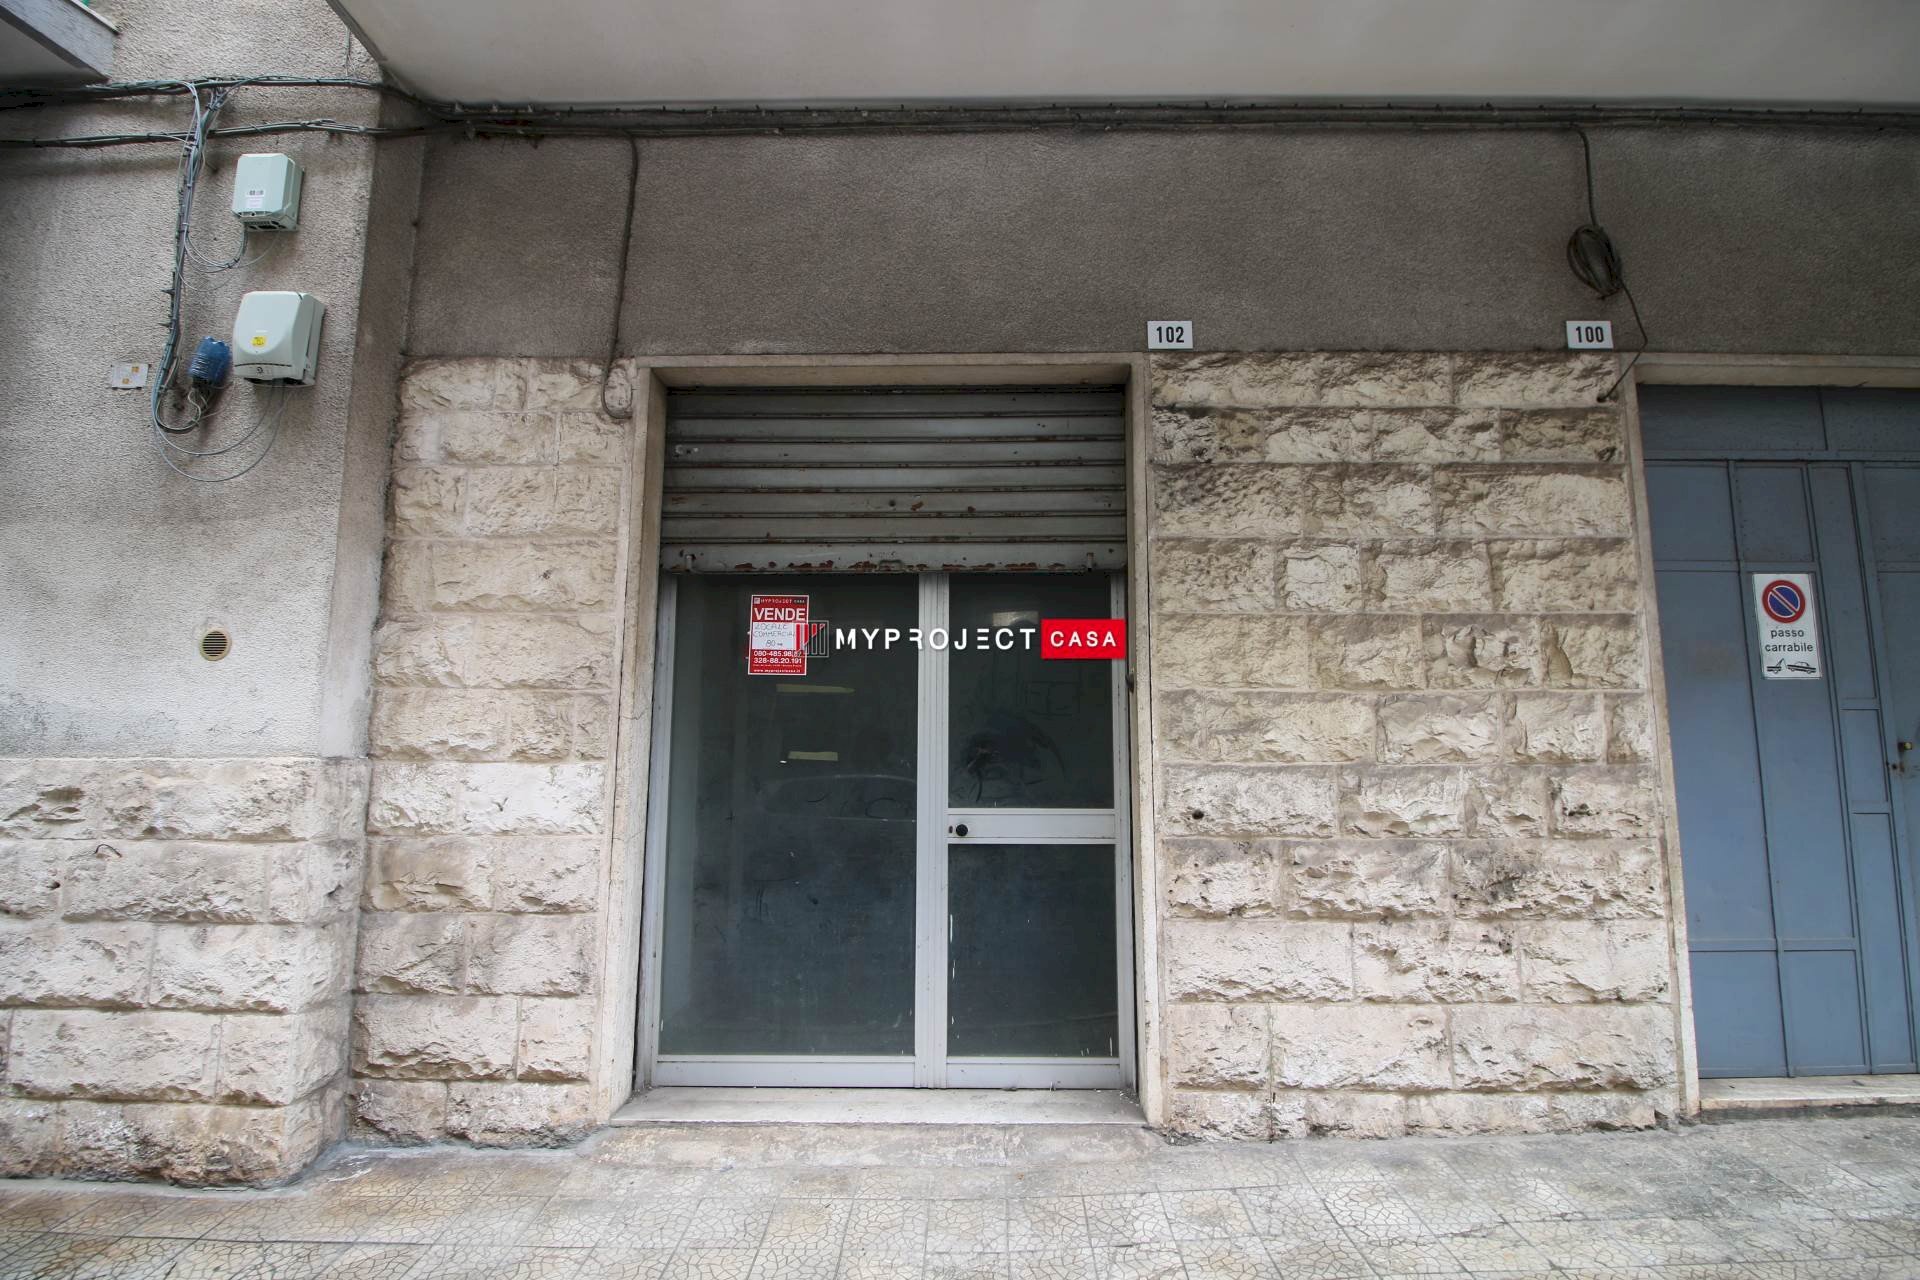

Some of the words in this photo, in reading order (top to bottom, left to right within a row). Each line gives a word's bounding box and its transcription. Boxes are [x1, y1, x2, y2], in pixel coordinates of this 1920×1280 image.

[1156, 326, 1184, 343] 102
[1576, 326, 1604, 343] 100
[754, 607, 806, 621] VENDE
[1770, 629, 1805, 639] passo
[1764, 643, 1814, 652] carrabile
